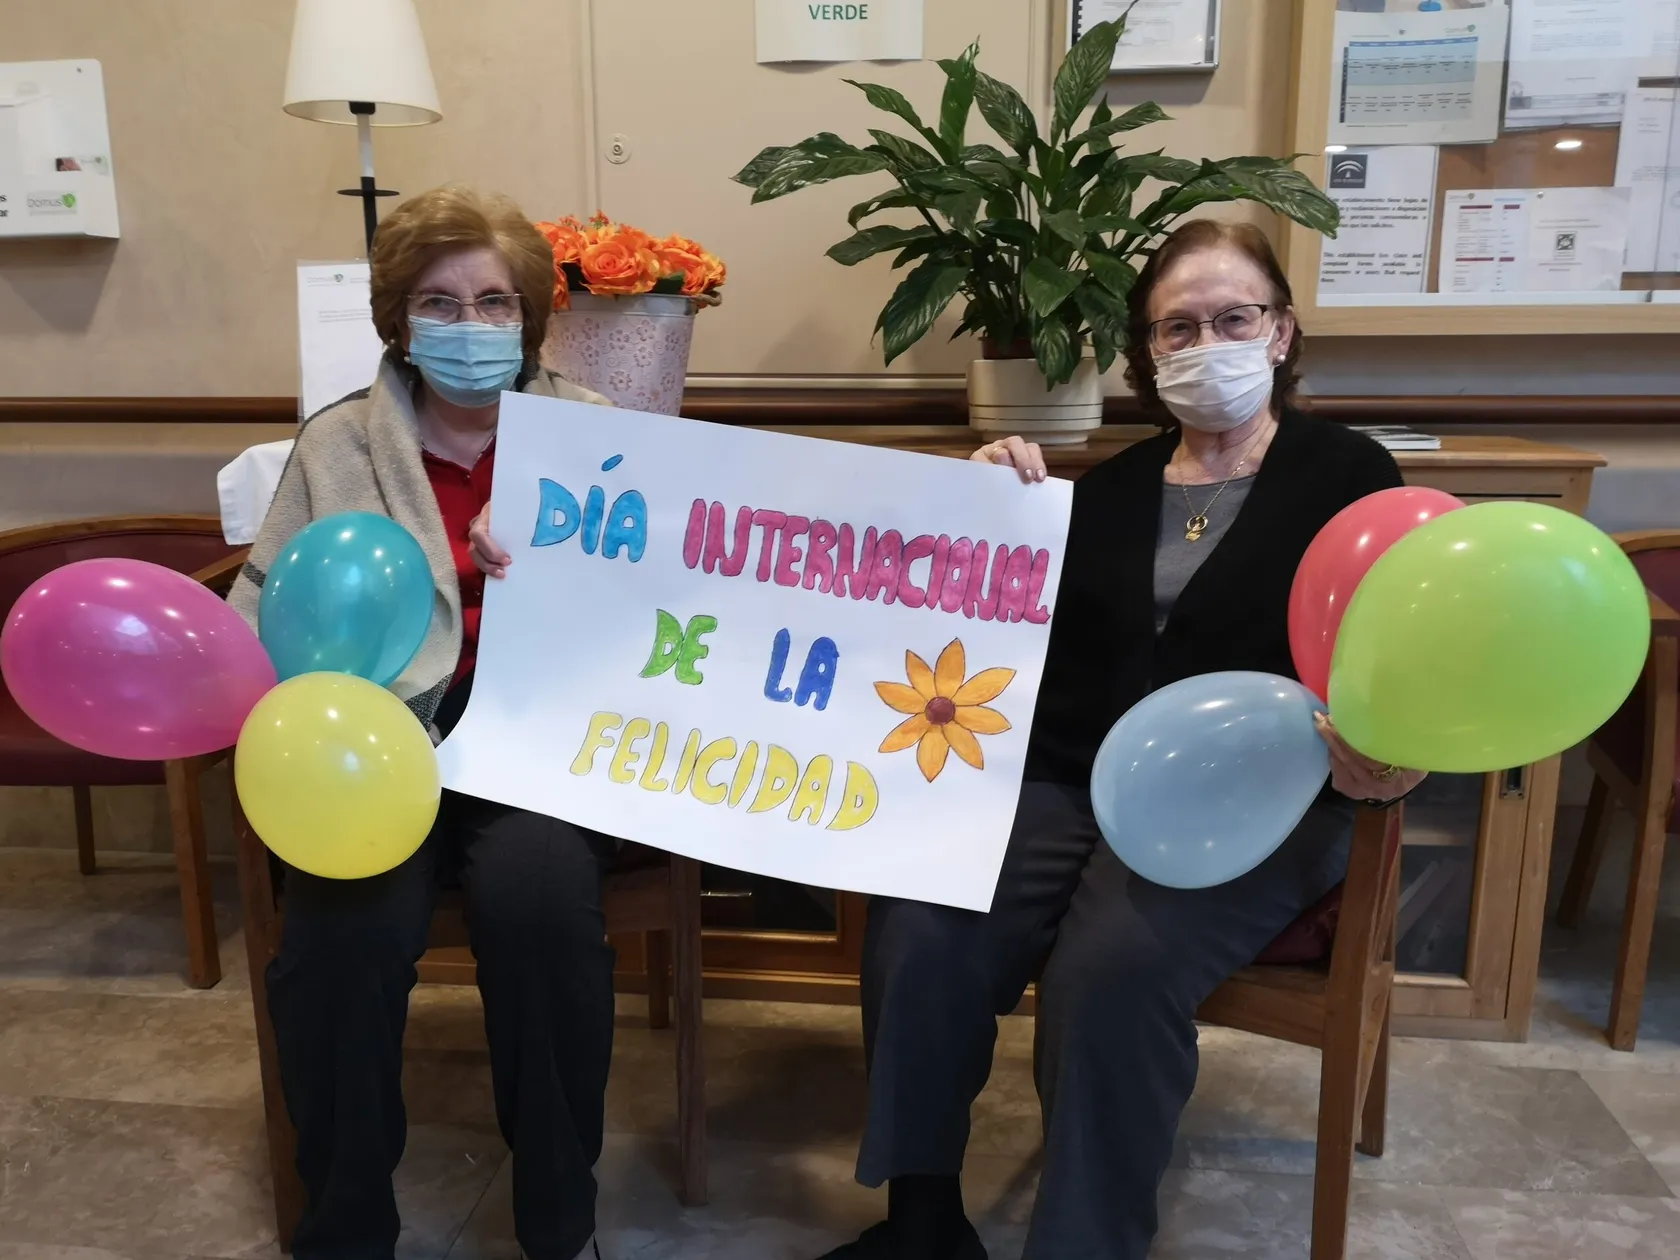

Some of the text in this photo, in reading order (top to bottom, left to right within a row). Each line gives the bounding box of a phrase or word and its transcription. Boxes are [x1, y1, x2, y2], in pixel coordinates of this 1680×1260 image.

[808, 4, 868, 20] VERDE
[530, 454, 1051, 625] DÍA INTERNACIONAL
[640, 608, 840, 711] DE LA
[569, 712, 879, 830] FELICIDAD
